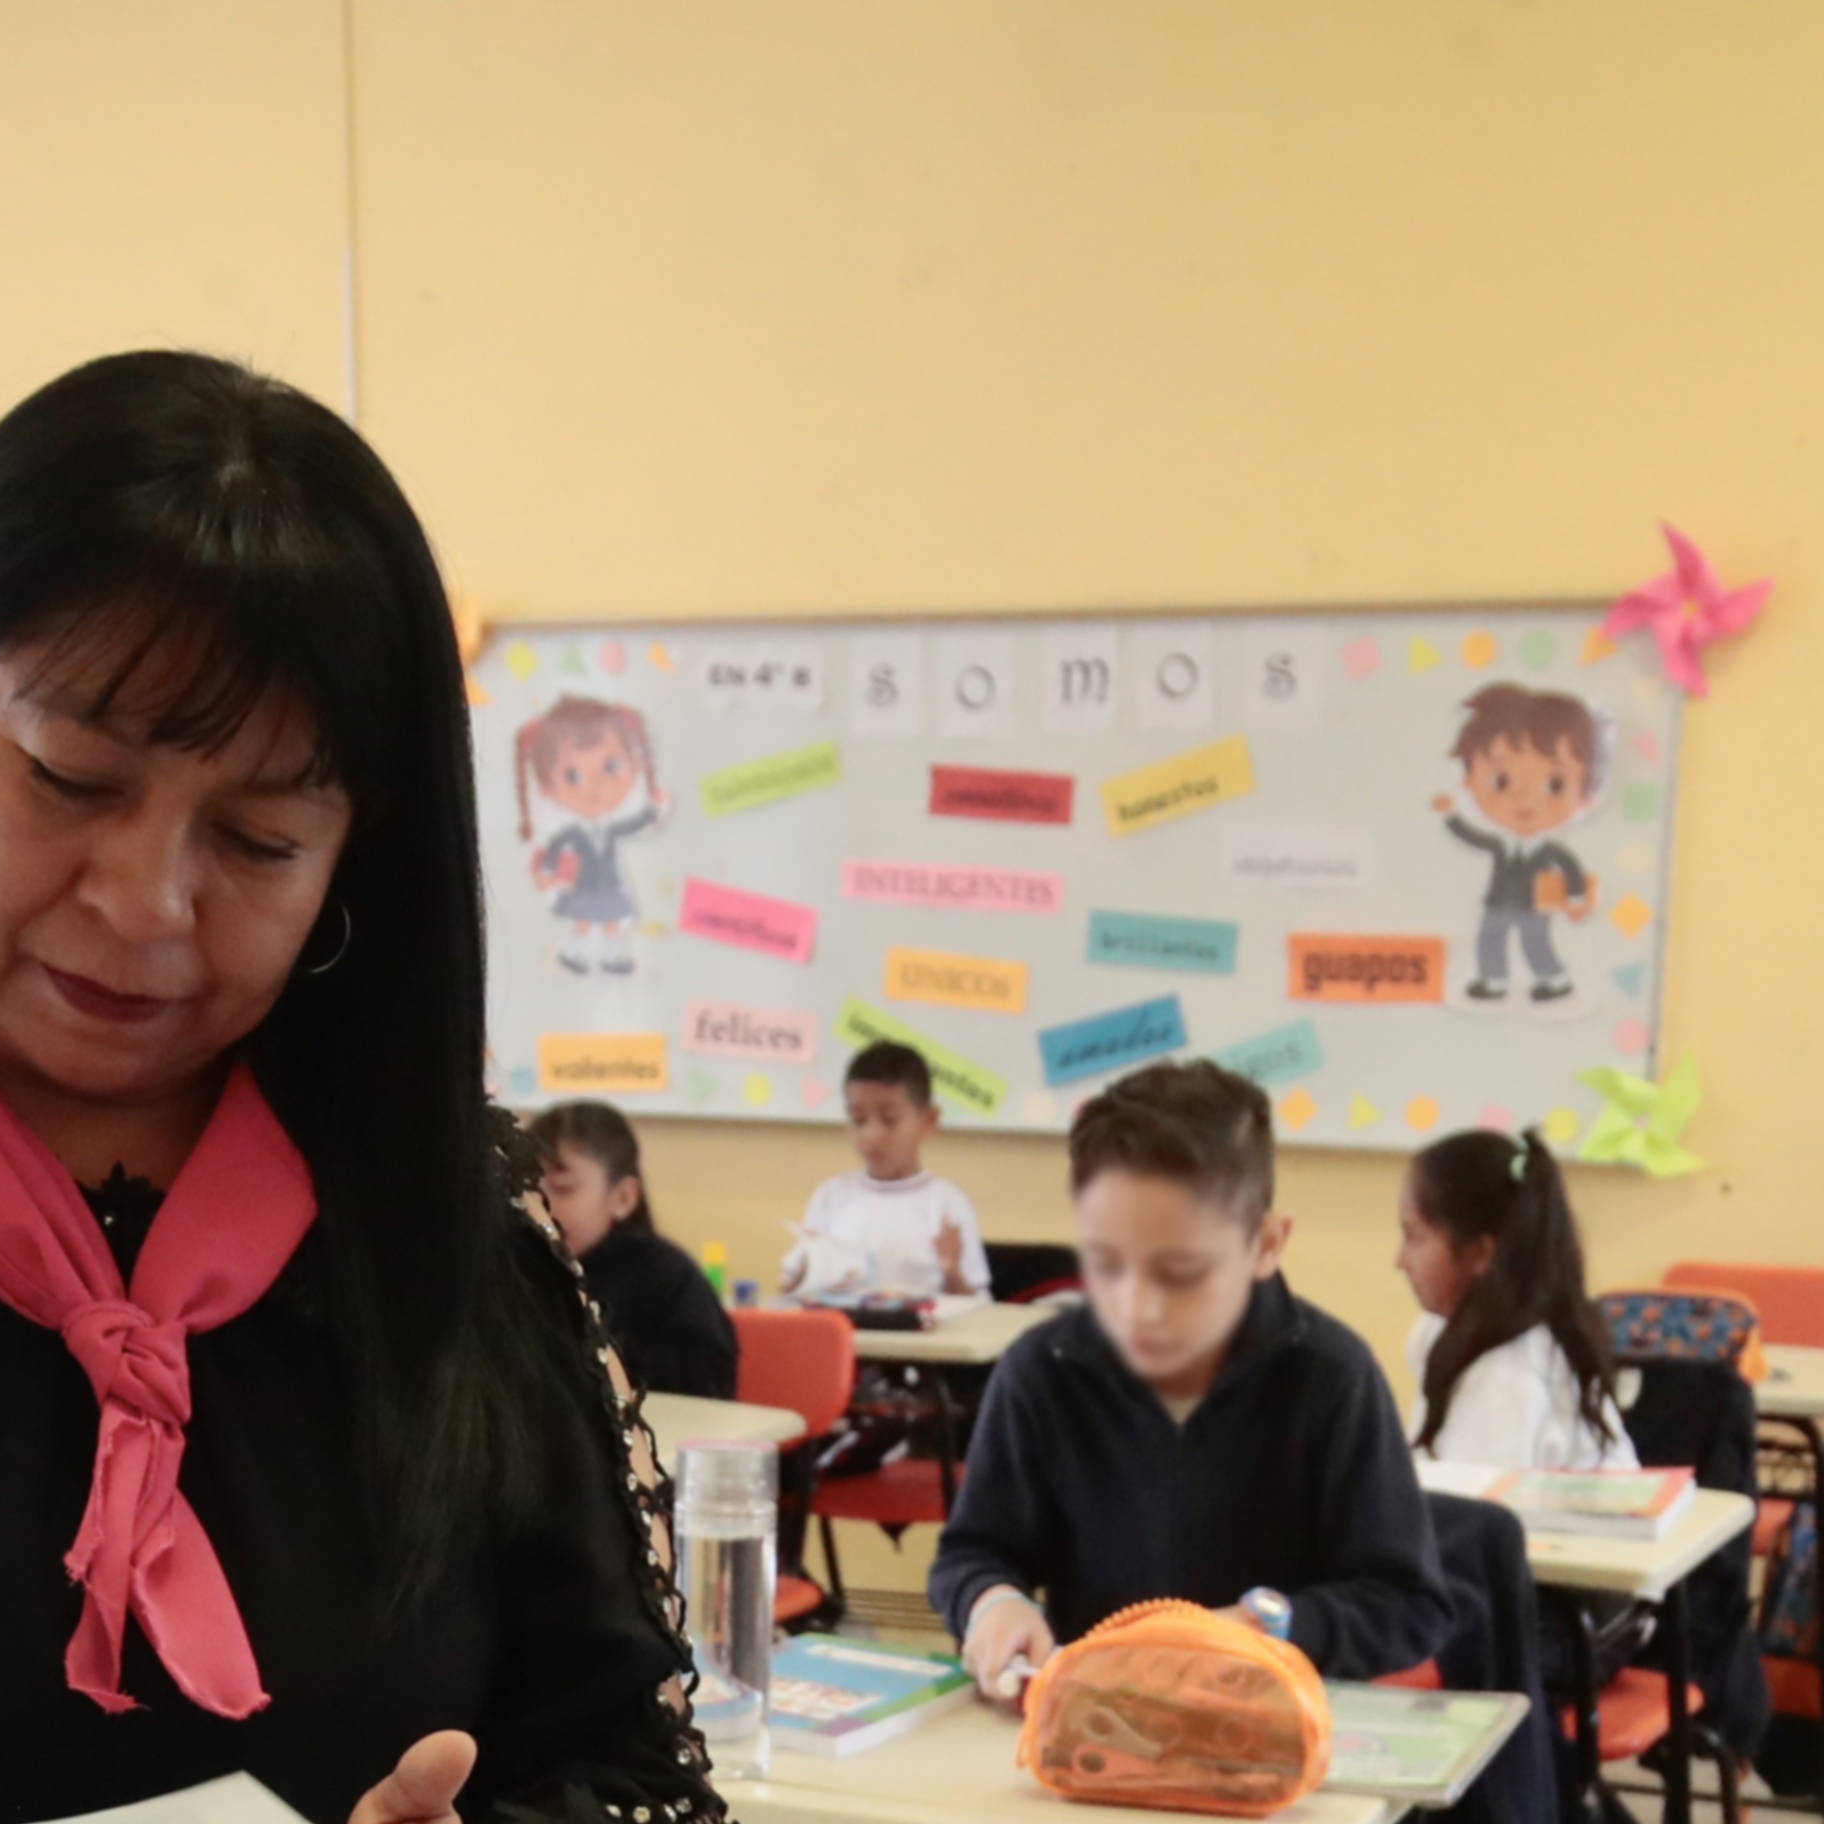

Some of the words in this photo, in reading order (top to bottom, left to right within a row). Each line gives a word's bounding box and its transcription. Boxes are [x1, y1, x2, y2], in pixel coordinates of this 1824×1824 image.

[853, 866, 1054, 906] INTELIGENTES
[1302, 950, 1429, 993] guapos
[693, 1008, 805, 1051] felices
